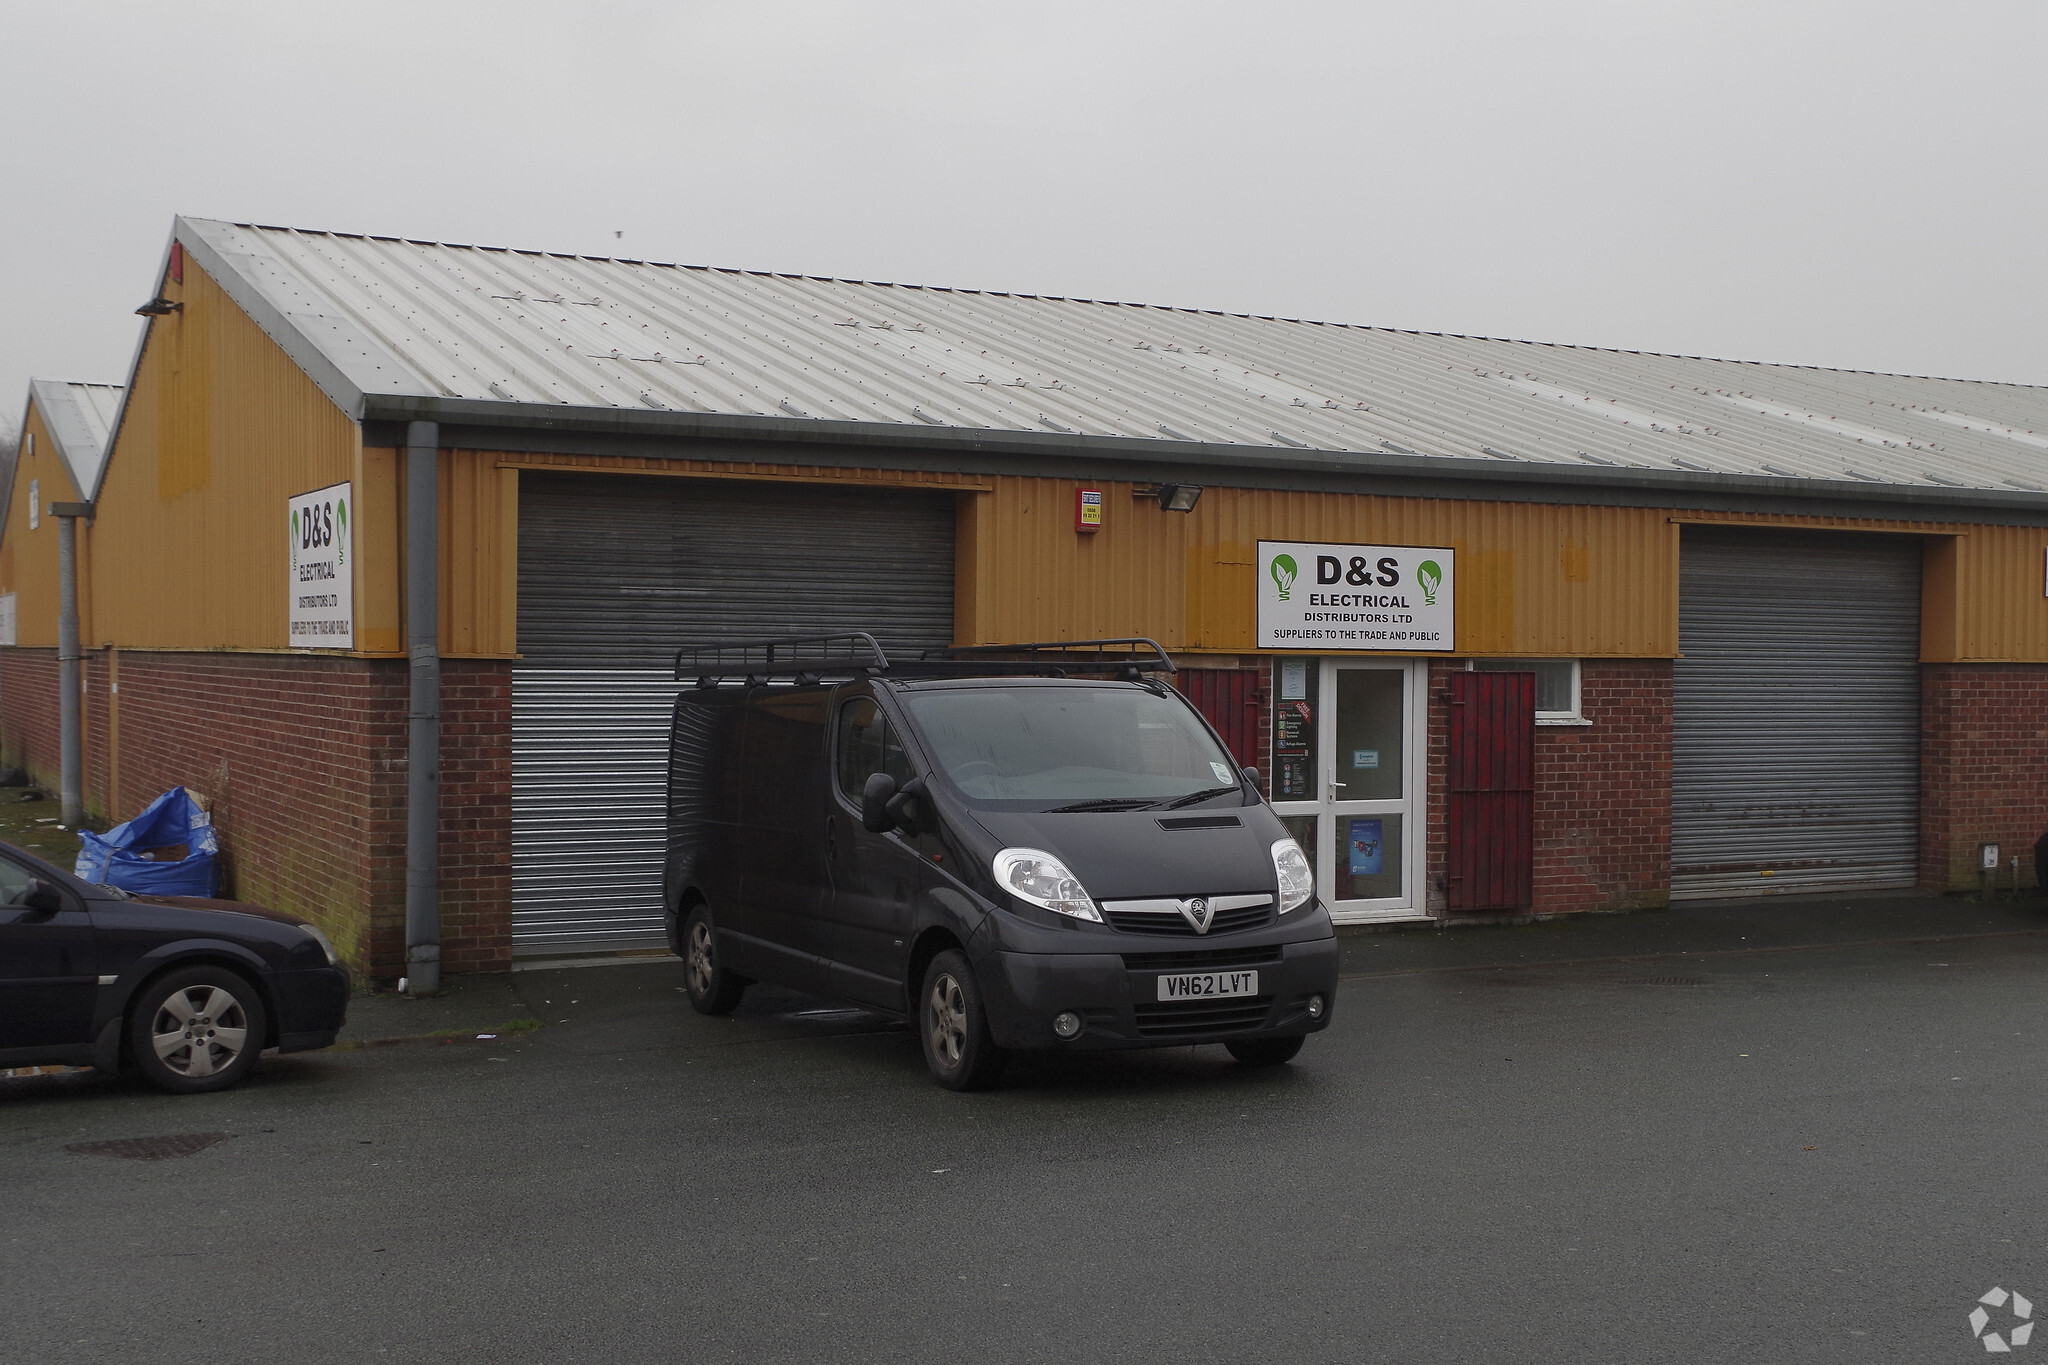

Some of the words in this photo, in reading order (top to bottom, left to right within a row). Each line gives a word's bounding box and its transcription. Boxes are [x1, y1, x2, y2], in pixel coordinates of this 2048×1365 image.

[303, 501, 332, 550] D&S
[299, 560, 335, 582] ELECTRICAL
[1317, 555, 1400, 587] D&S
[299, 595, 328, 608] DISTRIBUTORS
[329, 594, 338, 607] LTD
[1309, 593, 1410, 608] ELECTRICAL
[1304, 612, 1389, 623] DISTRIBUTORS
[1392, 614, 1413, 624] LTD
[1273, 629, 1323, 639] SUPPLIERS
[1325, 630, 1337, 639] TO
[1339, 630, 1357, 639] THE
[1359, 630, 1387, 640] TRADE
[1389, 631, 1407, 641] AND
[1409, 631, 1440, 641] PUBLIC
[1166, 975, 1214, 996] VN62
[1219, 973, 1251, 993] LVT
